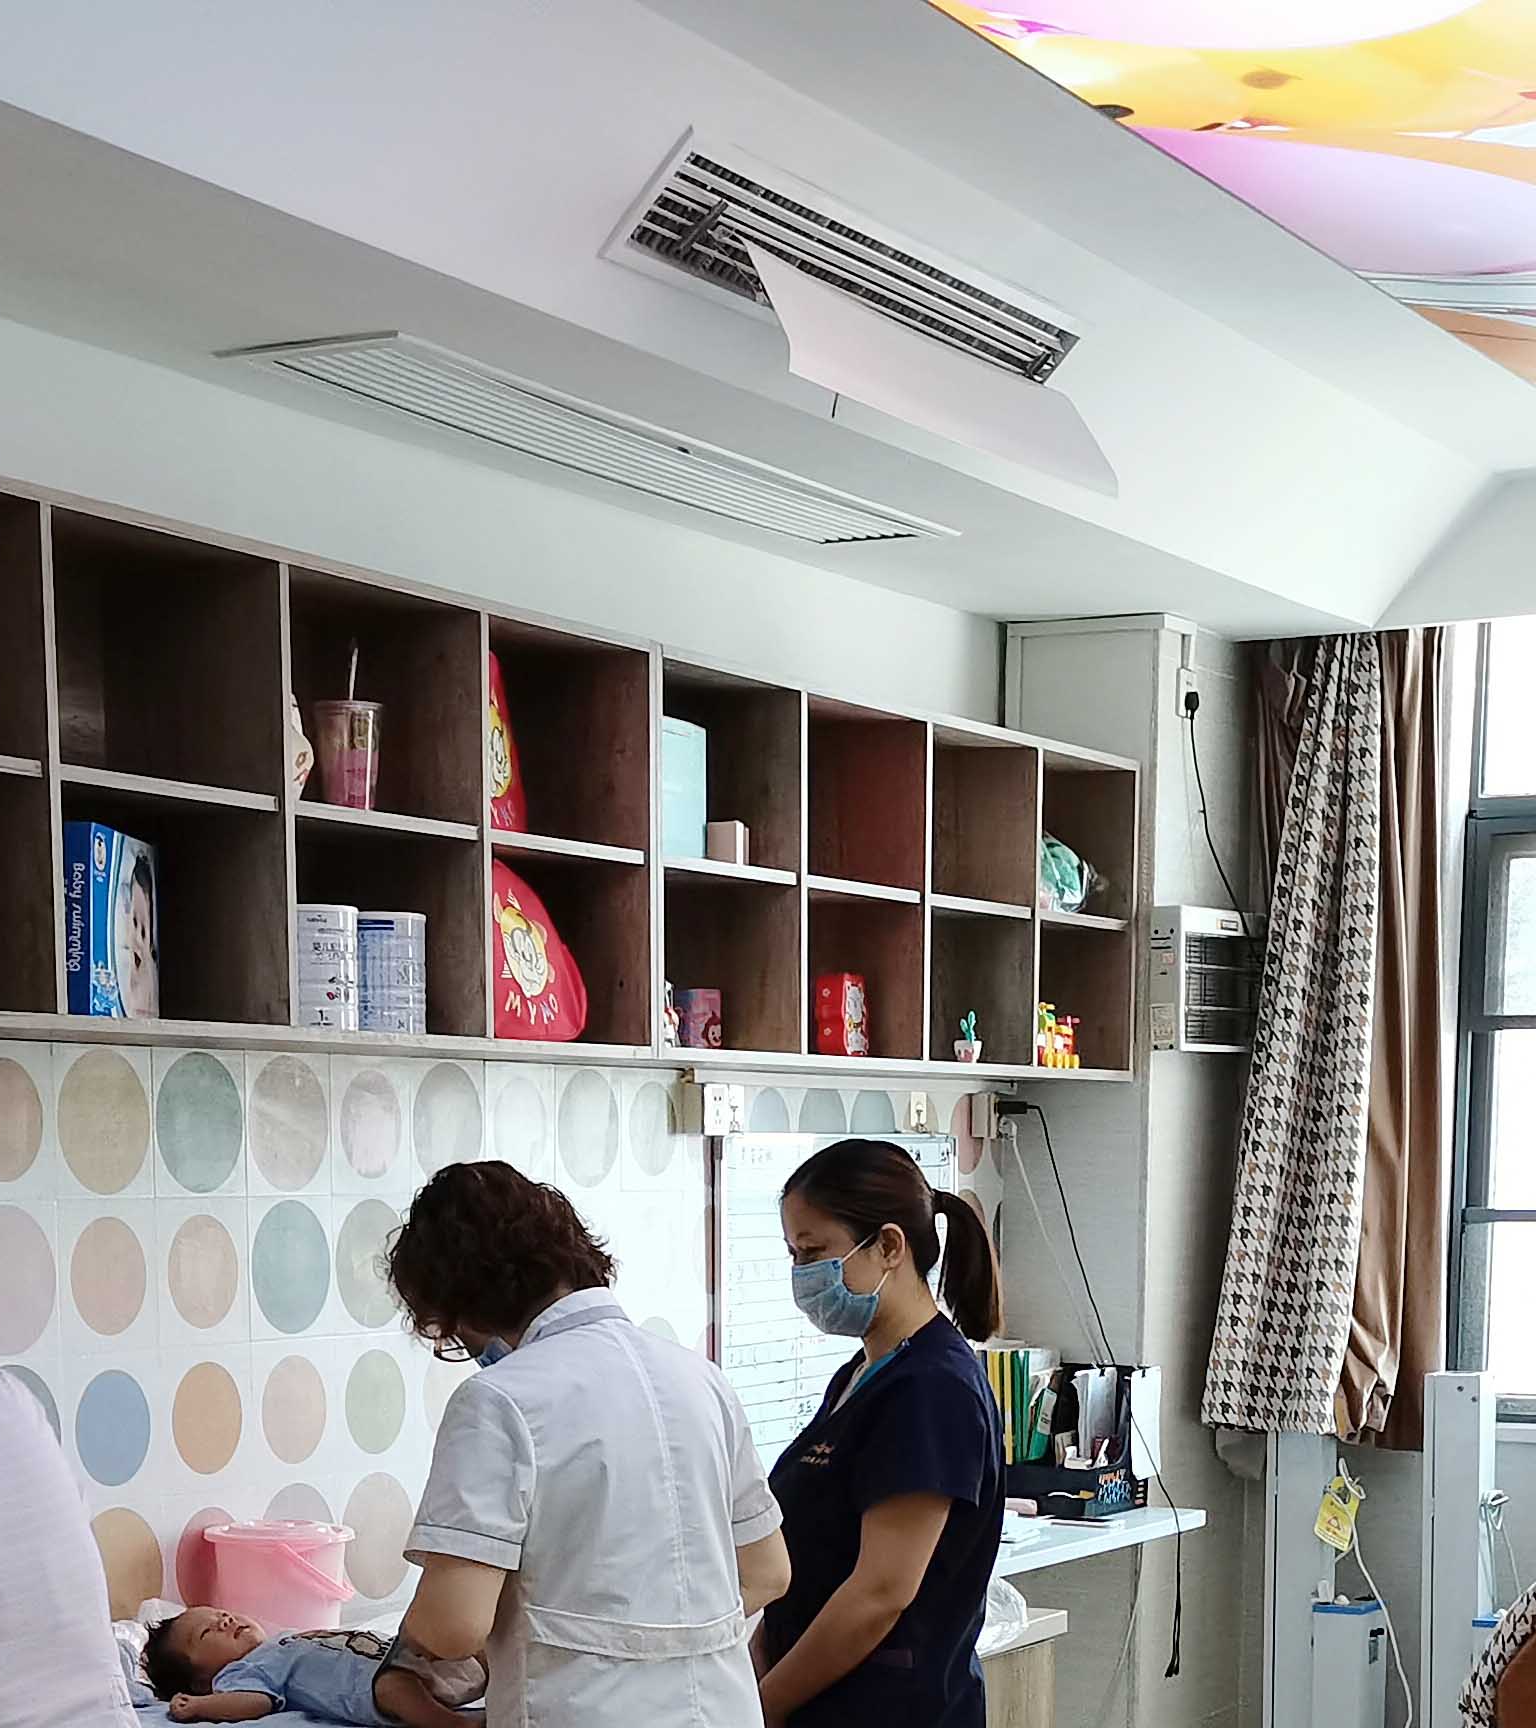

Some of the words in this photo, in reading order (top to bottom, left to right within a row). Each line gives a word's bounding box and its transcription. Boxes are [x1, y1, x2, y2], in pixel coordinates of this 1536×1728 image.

[69, 862, 86, 898] Baby
[66, 903, 86, 973] swimming
[504, 991, 559, 1026] MYMO
